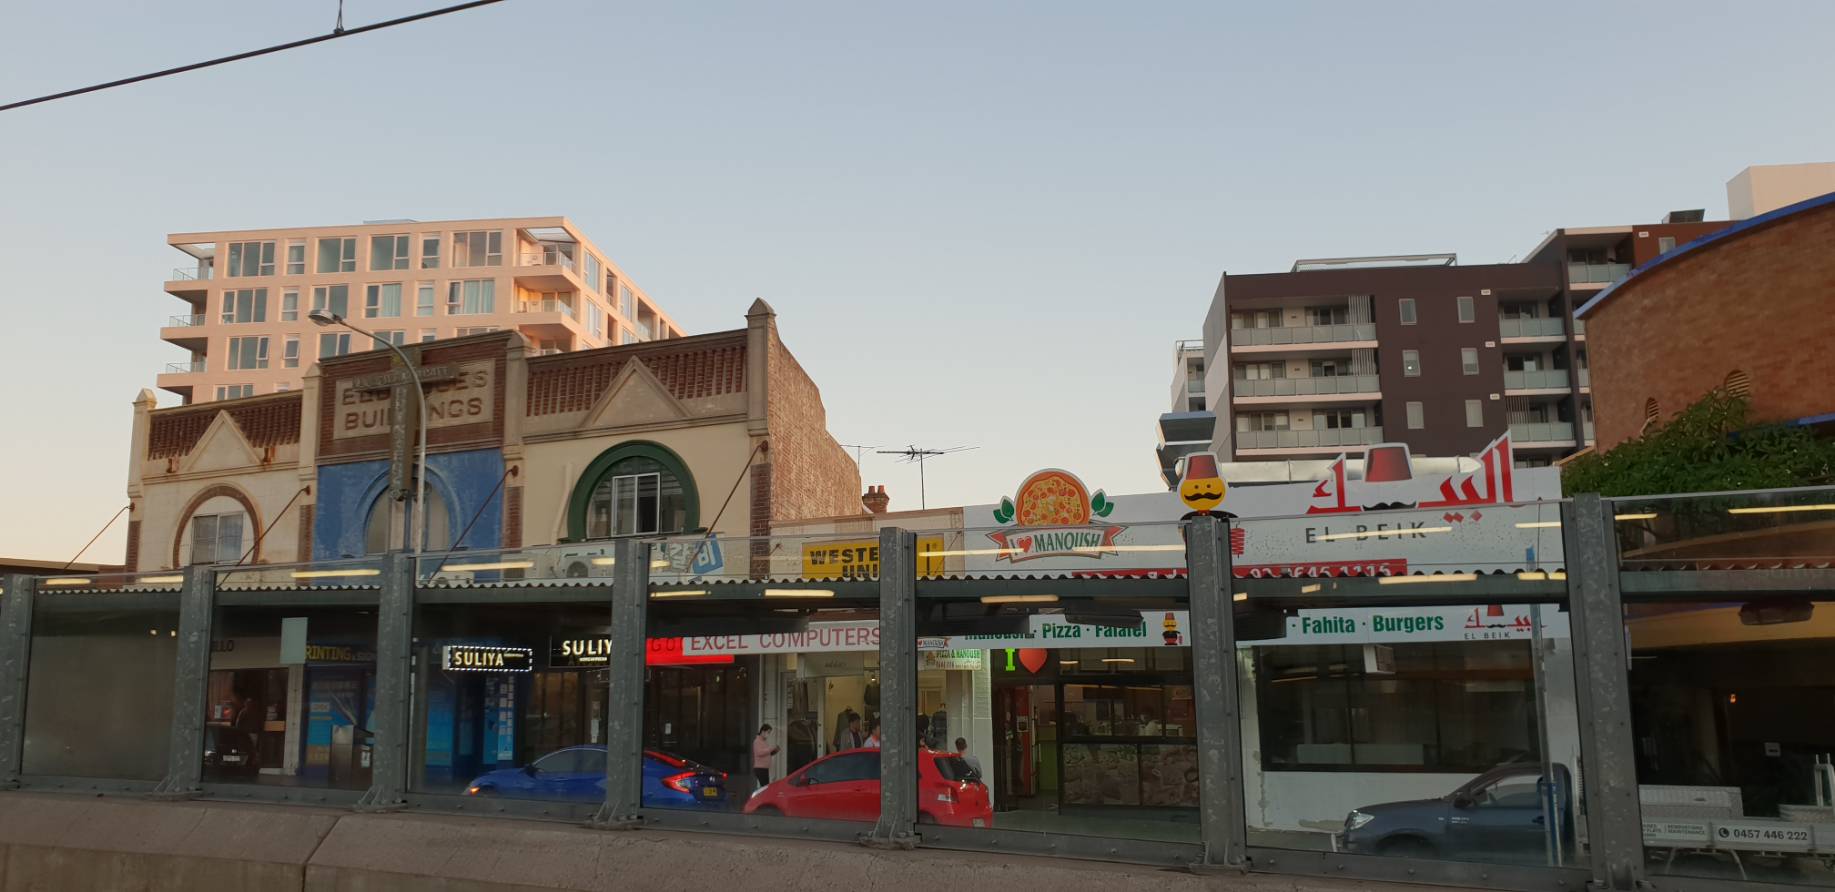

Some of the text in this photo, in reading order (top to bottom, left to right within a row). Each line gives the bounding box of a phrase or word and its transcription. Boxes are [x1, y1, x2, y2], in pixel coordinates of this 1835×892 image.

[1306, 521, 1427, 544] EL BEIK
[1033, 532, 1101, 552] MANOUSH
[810, 546, 880, 565] WESTE
[842, 563, 878, 578] UNI
[1042, 623, 1081, 639] Pizza
[1302, 615, 1444, 634] Fahita Burgers
[562, 639, 612, 656] SULIY
[691, 627, 880, 651] EXCEL COMPUTERS
[304, 645, 352, 661] RINTING
[454, 650, 505, 667] SULIYA
[1733, 829, 1760, 839] 0457
[1786, 831, 1808, 841] 222
